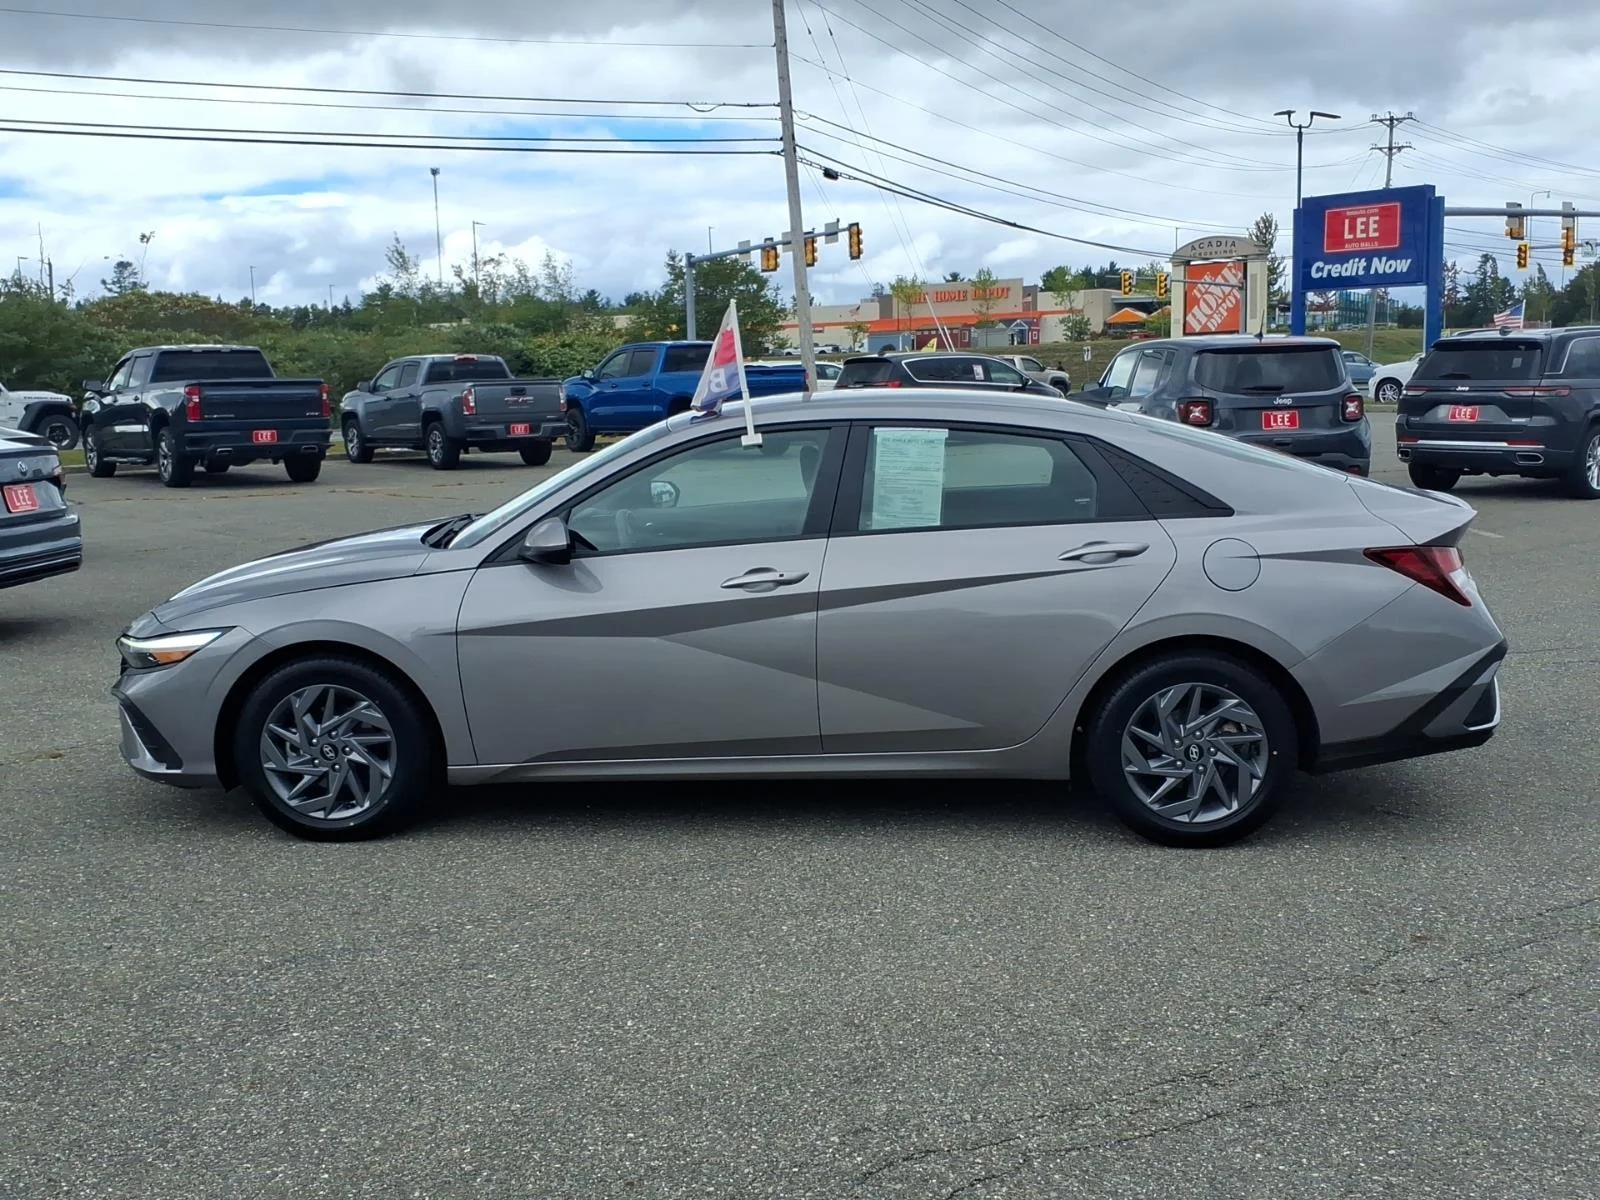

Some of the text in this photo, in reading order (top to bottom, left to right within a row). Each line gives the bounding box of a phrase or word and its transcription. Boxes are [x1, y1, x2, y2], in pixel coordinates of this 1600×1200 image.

[1344, 216, 1380, 239] LEE
[1191, 240, 1236, 252] ACADIA
[1311, 257, 1412, 279] Credit Now
[1192, 271, 1215, 299] THE
[933, 290, 968, 303] HOME
[1186, 262, 1243, 332] HOME
[1206, 286, 1241, 331] DEPOT
[1273, 397, 1292, 405] Jeep
[1270, 414, 1291, 426] LEE
[1455, 408, 1472, 418] LEE
[258, 432, 272, 441] LEE
[11, 489, 32, 506] LEE
